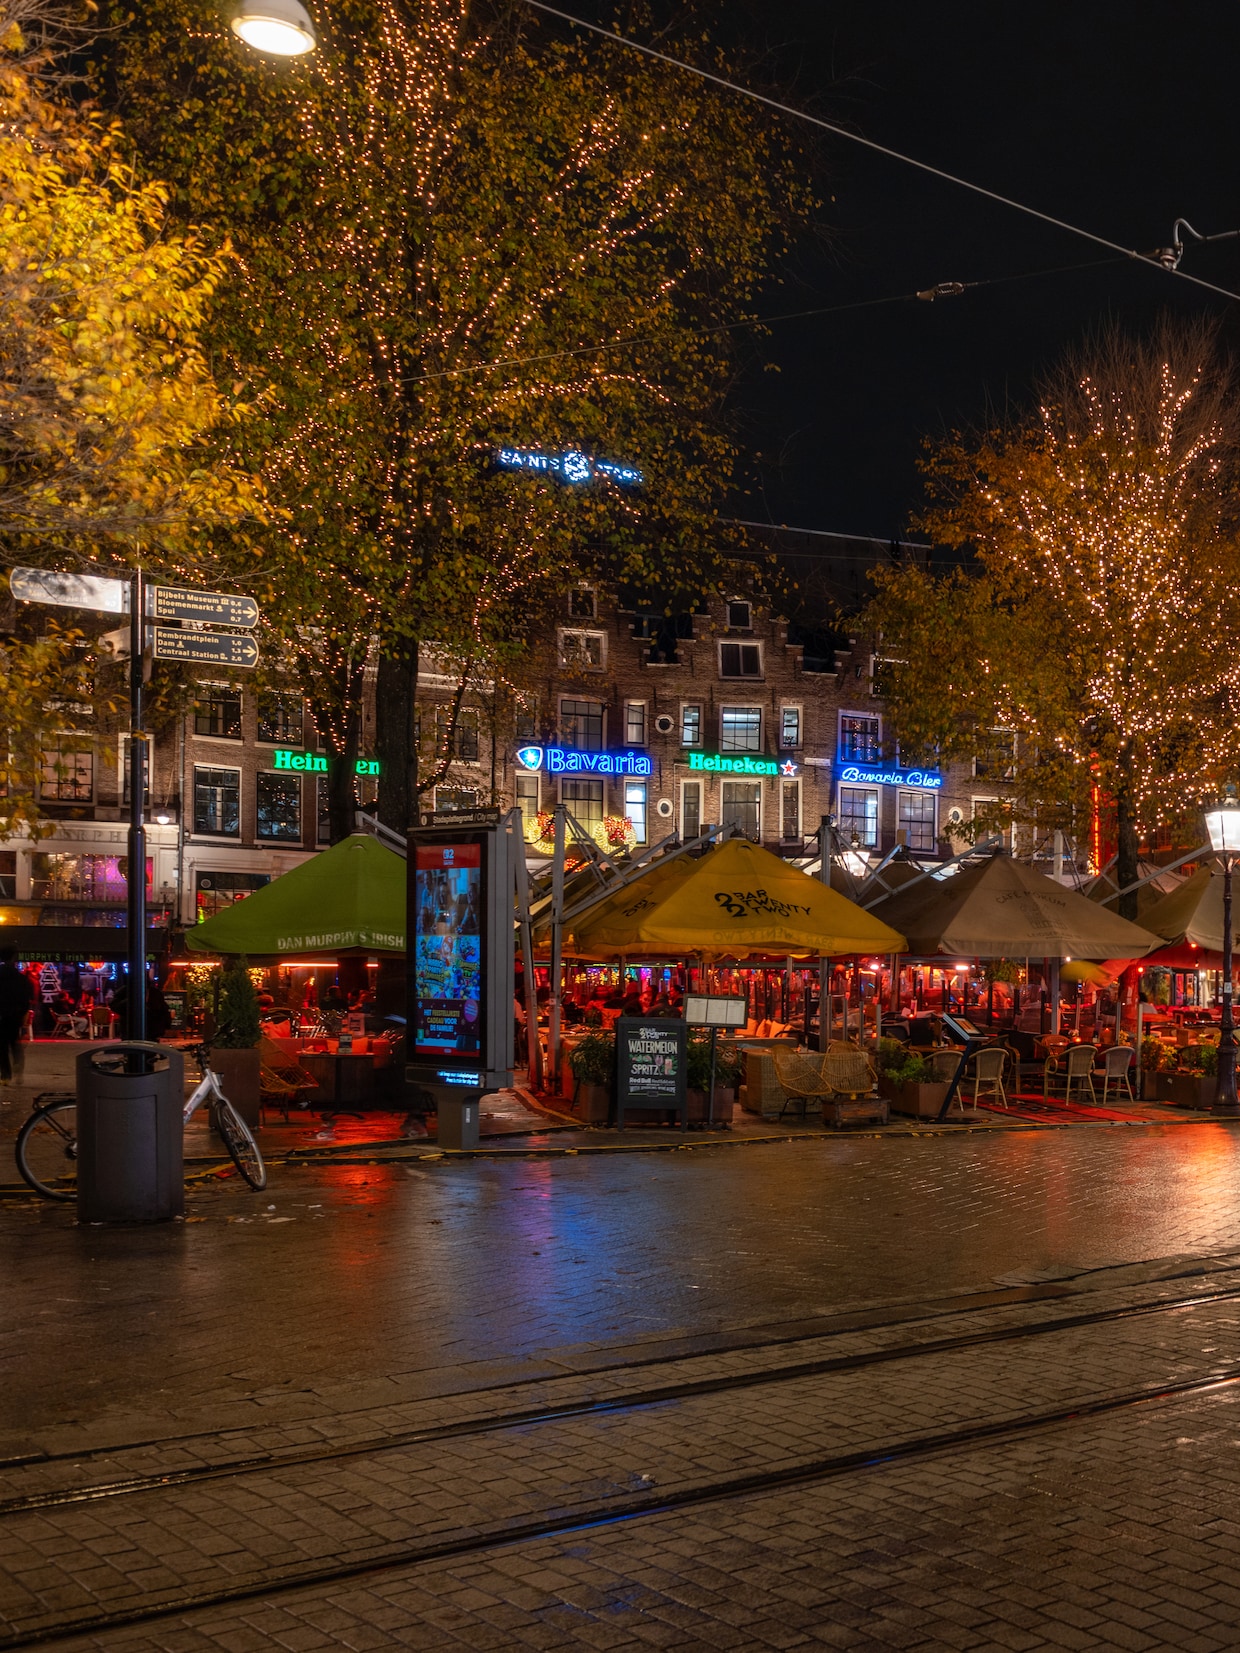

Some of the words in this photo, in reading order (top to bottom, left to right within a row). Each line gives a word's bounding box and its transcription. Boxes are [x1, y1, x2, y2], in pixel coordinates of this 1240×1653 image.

[158, 590, 185, 600] Bijbels
[187, 594, 219, 605] Museum
[158, 599, 214, 612] Bloemenmarkt
[158, 606, 175, 615] Spui
[158, 631, 219, 644] Rembrandtplein
[158, 647, 190, 657] Centraal
[191, 651, 219, 660] Station
[274, 750, 380, 775] Heinen
[546, 748, 652, 775] Bavaria
[689, 753, 778, 775] Heineken
[841, 767, 904, 784] Bavaria
[733, 889, 767, 900] BAR
[742, 897, 811, 915] TWENTY
[752, 906, 790, 917] TWO
[278, 937, 302, 949] DAN
[372, 933, 404, 947] IRISH
[628, 1040, 678, 1054] WATERMELON
[631, 1064, 659, 1075] SPRITZ
